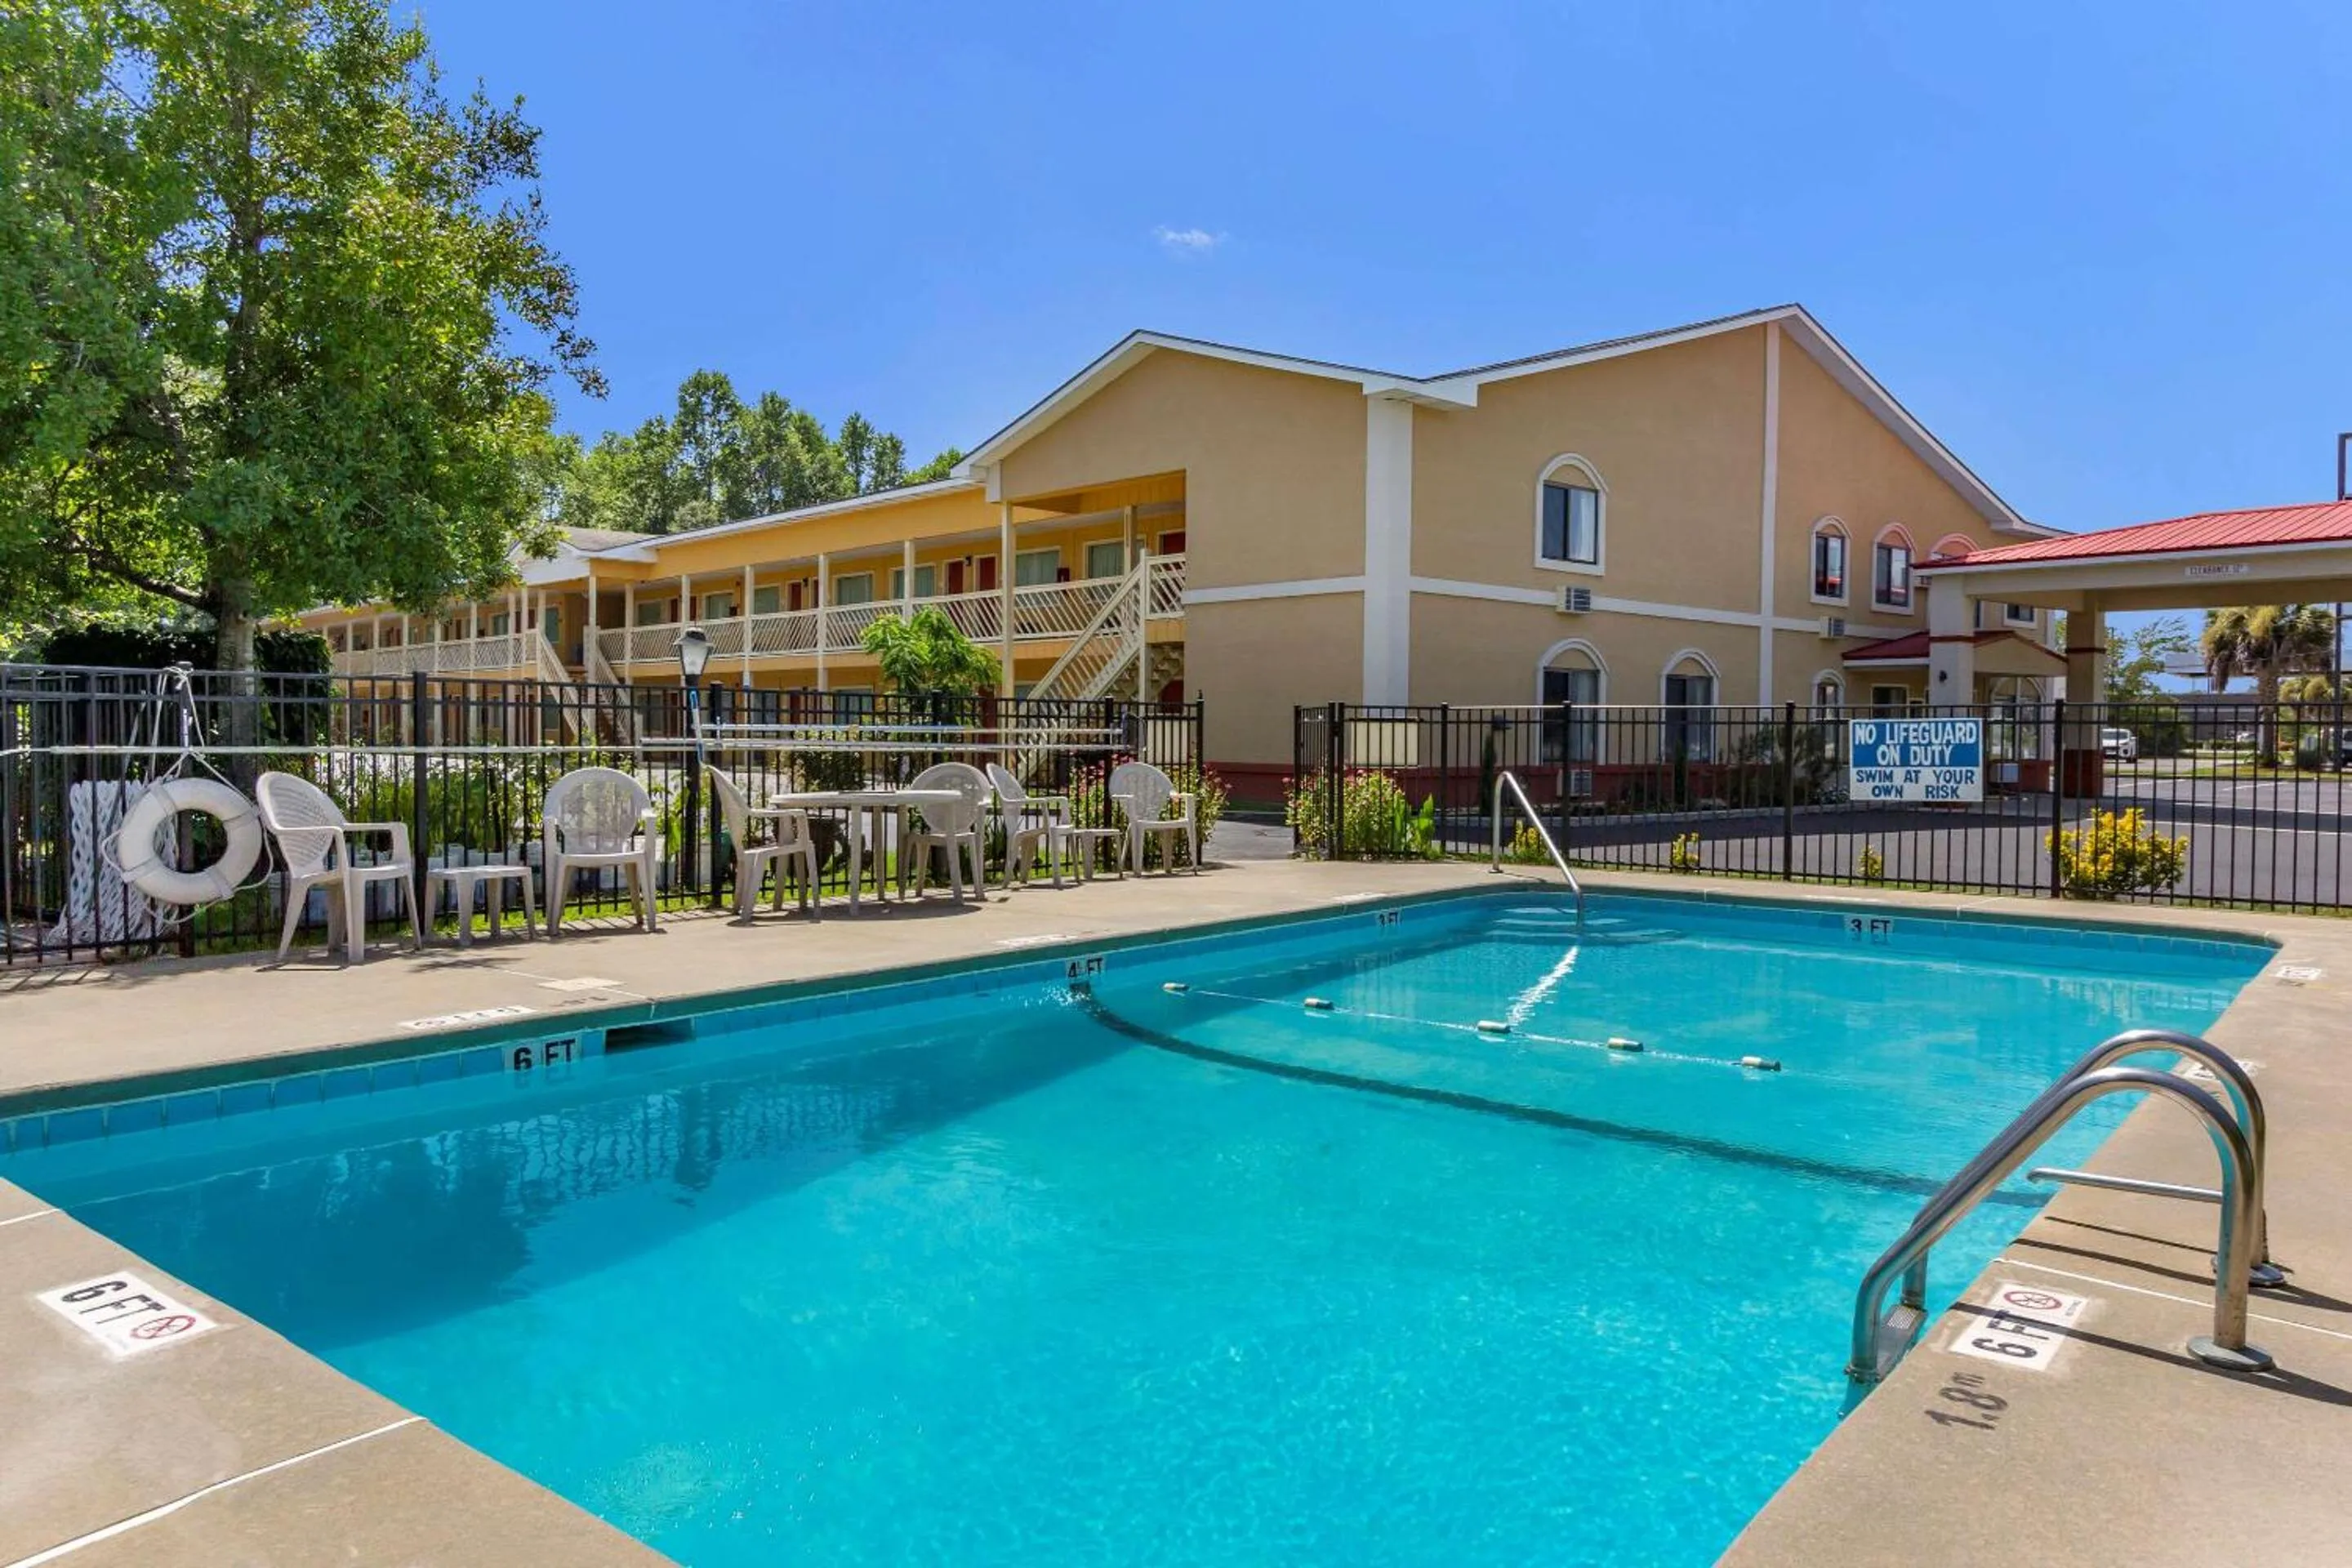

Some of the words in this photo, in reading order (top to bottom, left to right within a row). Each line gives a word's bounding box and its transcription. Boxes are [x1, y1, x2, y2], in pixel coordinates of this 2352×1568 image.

[1855, 724, 1876, 745] NO
[1886, 722, 1977, 745] LIFEGUARD
[1877, 745, 1900, 765] ON
[1909, 745, 1953, 765] DUTY
[1856, 769, 1893, 783] SWIM
[1904, 769, 1921, 784] AT
[1933, 769, 1974, 784] YOUR
[1871, 785, 1903, 799] OWN
[1925, 785, 1960, 799] RISK
[1851, 919, 1862, 934] 3
[1870, 920, 1891, 934] FT
[1086, 958, 1103, 976] FT
[514, 1047, 532, 1071] 6
[545, 1038, 576, 1067] FT
[60, 1281, 127, 1303] 6
[78, 1294, 167, 1324] FT
[1971, 1338, 2038, 1358] 6
